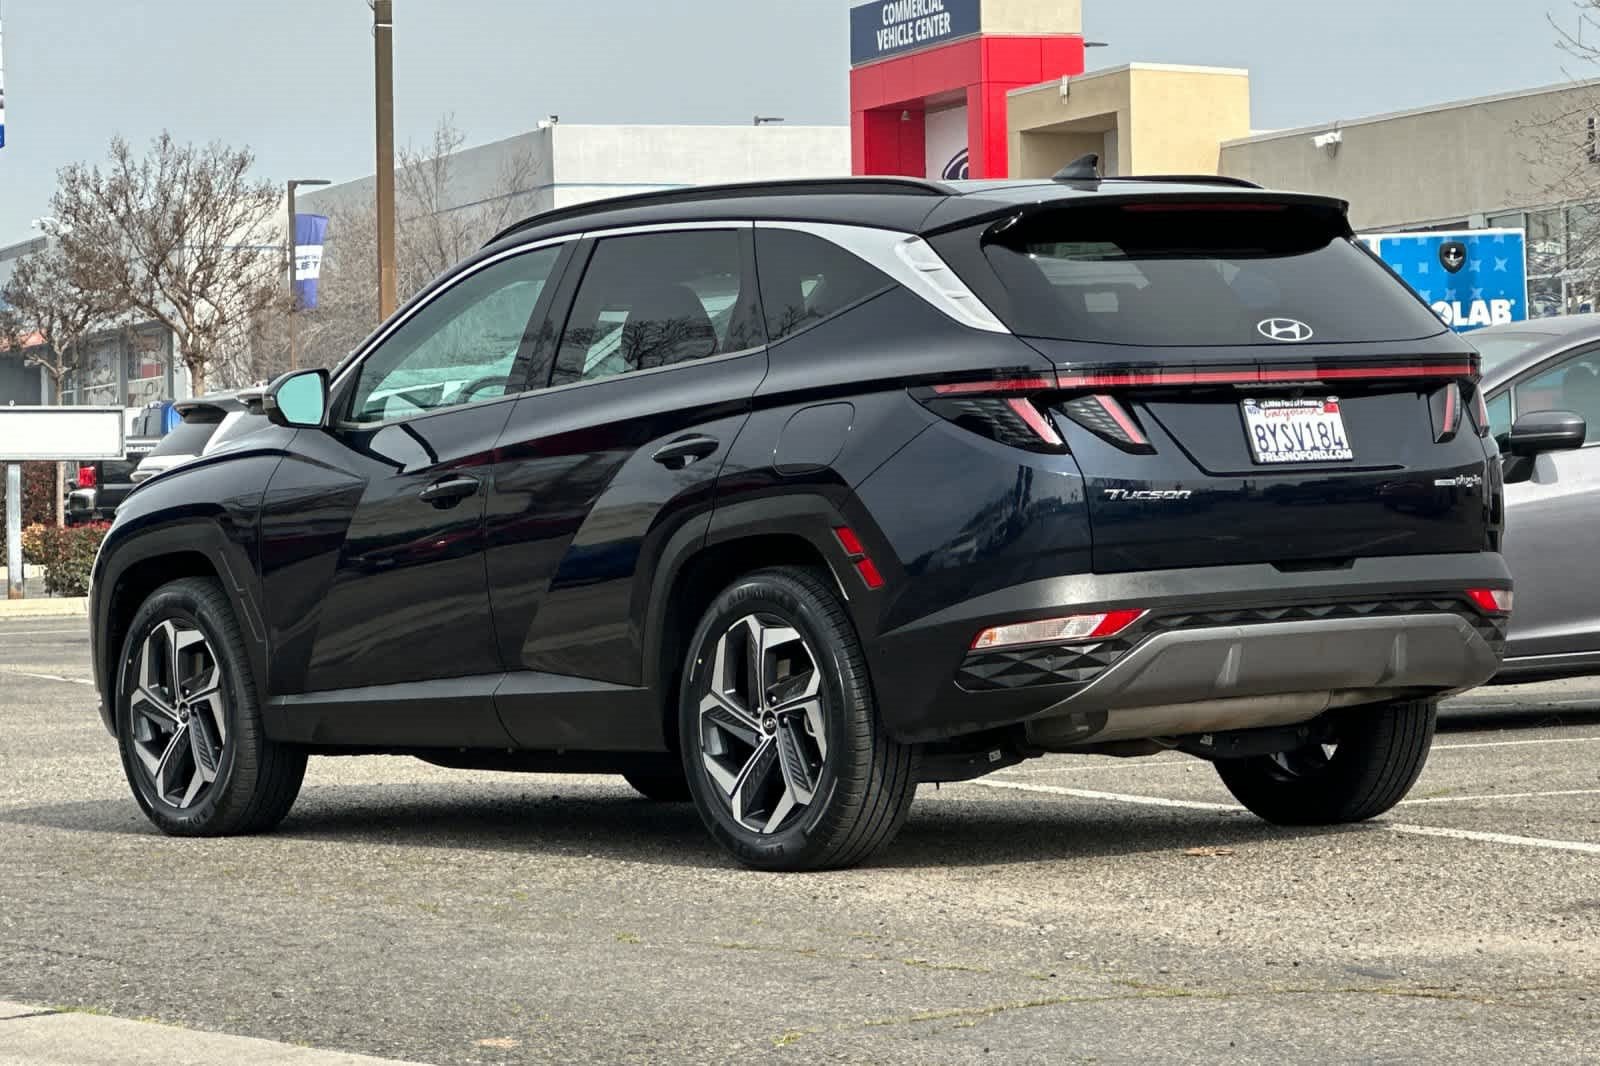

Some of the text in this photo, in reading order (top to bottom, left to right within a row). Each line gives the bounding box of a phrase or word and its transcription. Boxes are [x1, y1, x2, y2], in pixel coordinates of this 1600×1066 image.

[882, 0, 945, 26] COMMERCIAL
[876, 12, 951, 51] VEHICLE CENTER
[1255, 421, 1344, 453] 8YSV184
[1258, 448, 1353, 462] FRESNOFORD.COM
